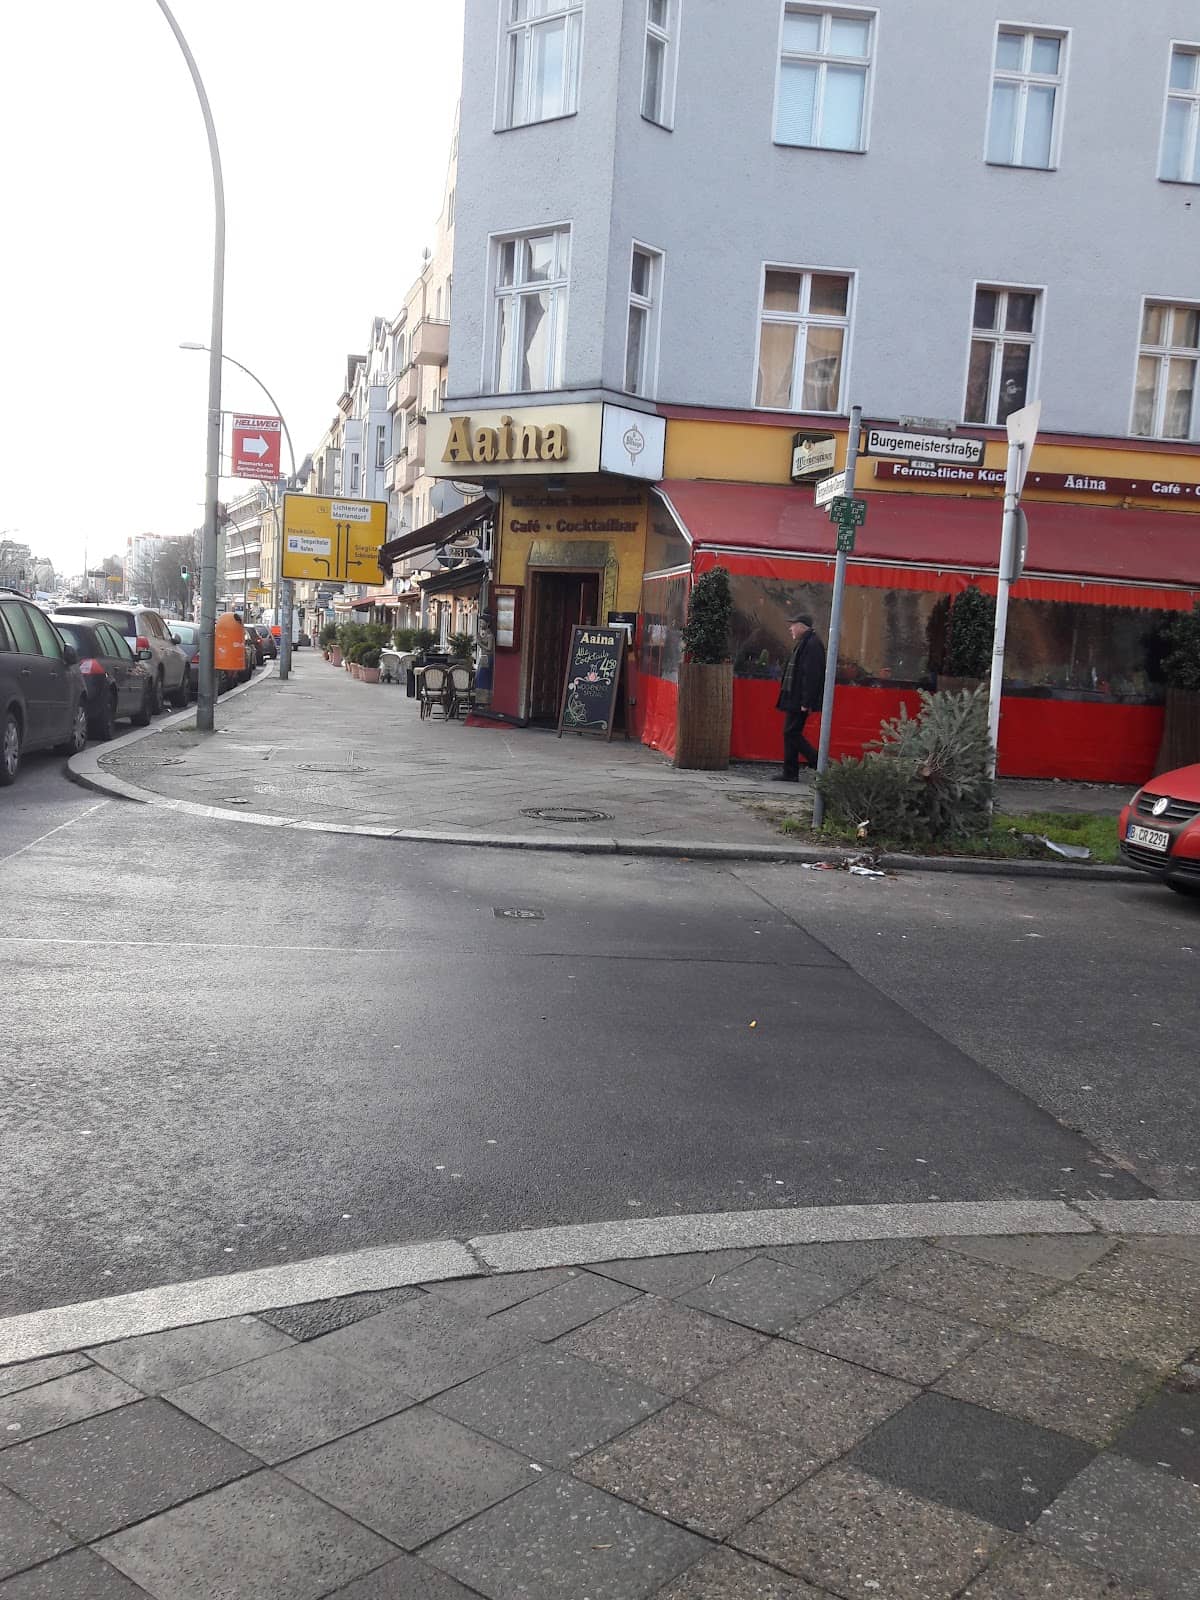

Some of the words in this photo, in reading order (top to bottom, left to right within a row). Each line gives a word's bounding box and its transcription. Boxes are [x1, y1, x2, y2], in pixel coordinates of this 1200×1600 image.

[234, 419, 279, 428] HELLWEG
[441, 415, 568, 462] Aaina
[870, 432, 979, 459] Burgemeisterstraße
[978, 470, 1007, 482] Küc
[1064, 475, 1106, 491] Aaina
[1152, 482, 1181, 494] Café
[333, 504, 369, 513] Lichtenrade
[332, 512, 367, 520] Mariendorf
[510, 519, 540, 533] Café
[580, 632, 615, 646] Aaina
[1148, 832, 1168, 847] 2291
